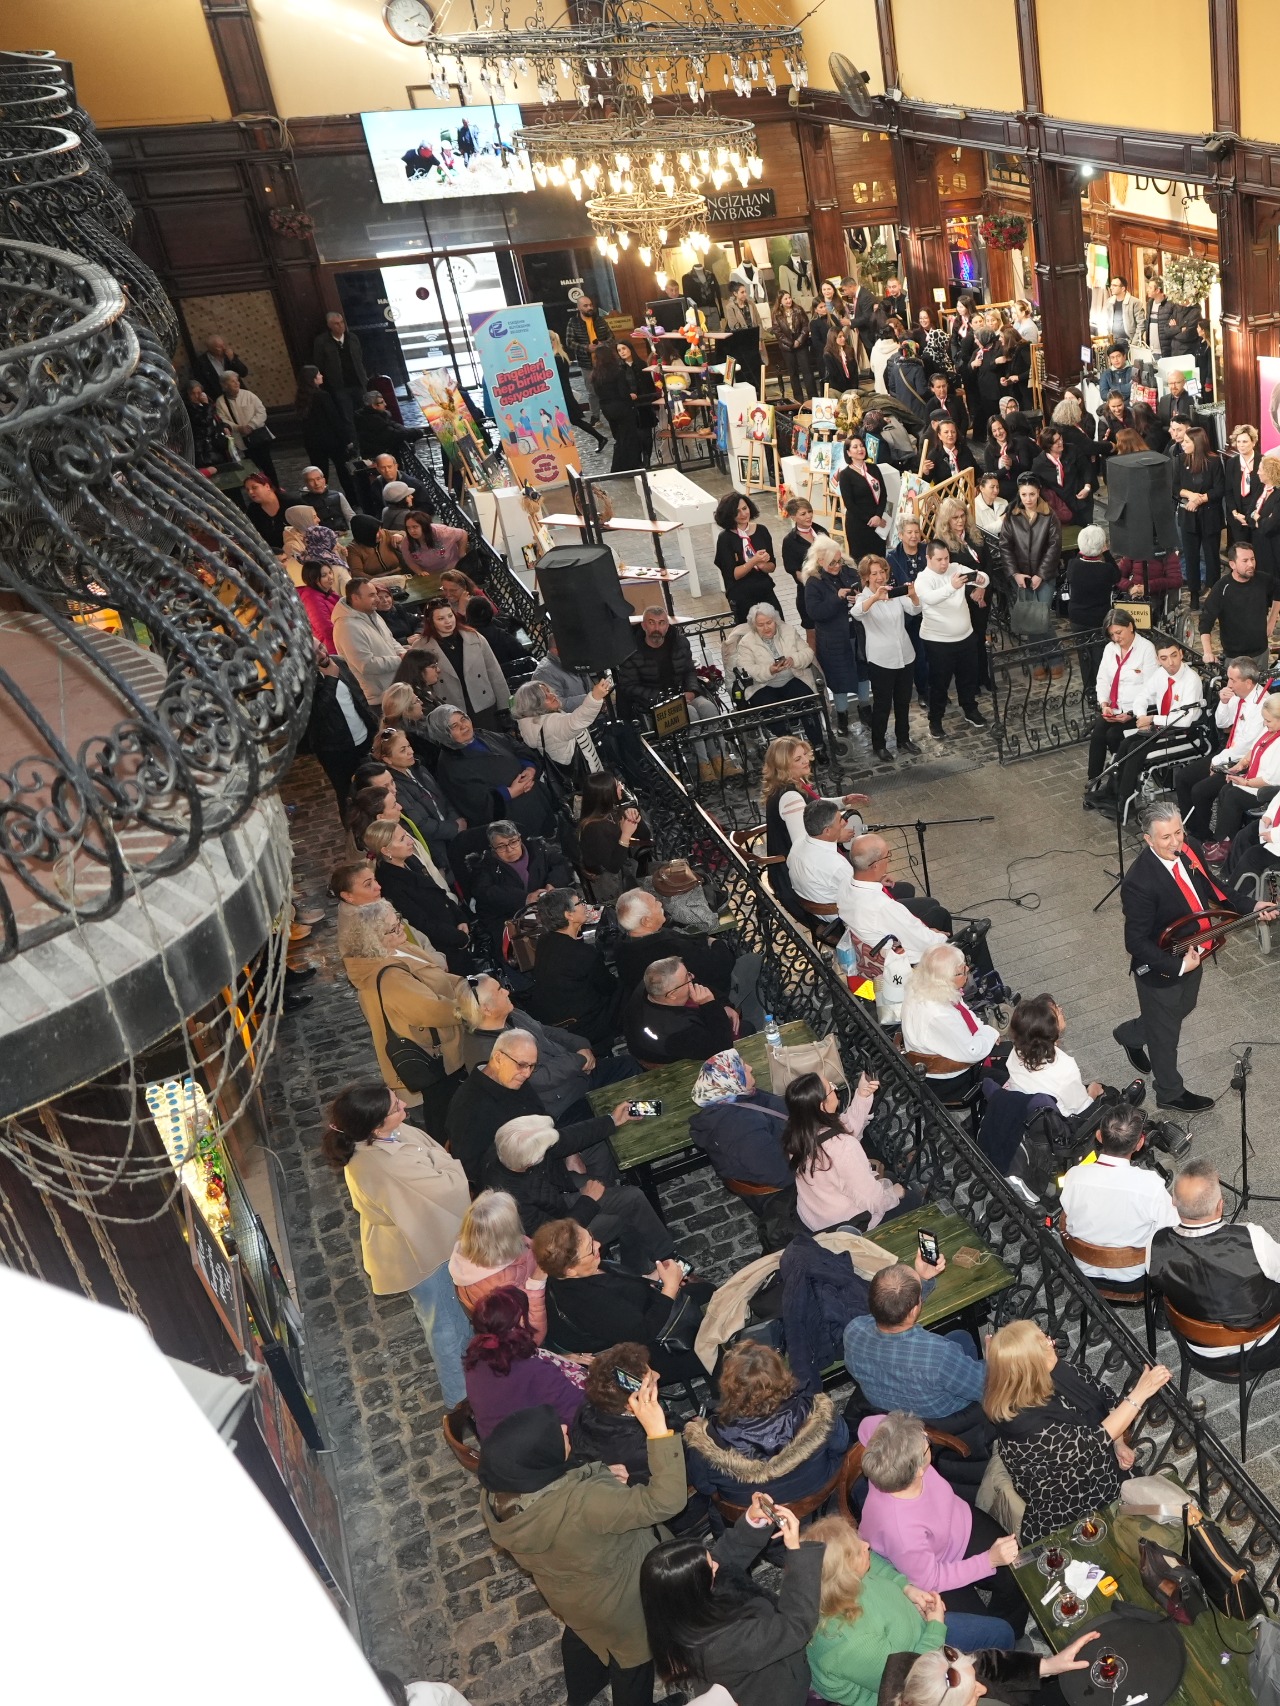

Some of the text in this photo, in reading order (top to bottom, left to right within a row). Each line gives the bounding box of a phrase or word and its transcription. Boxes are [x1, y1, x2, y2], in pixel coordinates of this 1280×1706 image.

[707, 191, 770, 210] NGİZHAN
[705, 205, 762, 221] BAYBARS
[560, 278, 584, 286] HALLER
[497, 358, 545, 384] Engelleri
[492, 383, 515, 397] hep
[500, 381, 550, 406] aşıyoruz.
